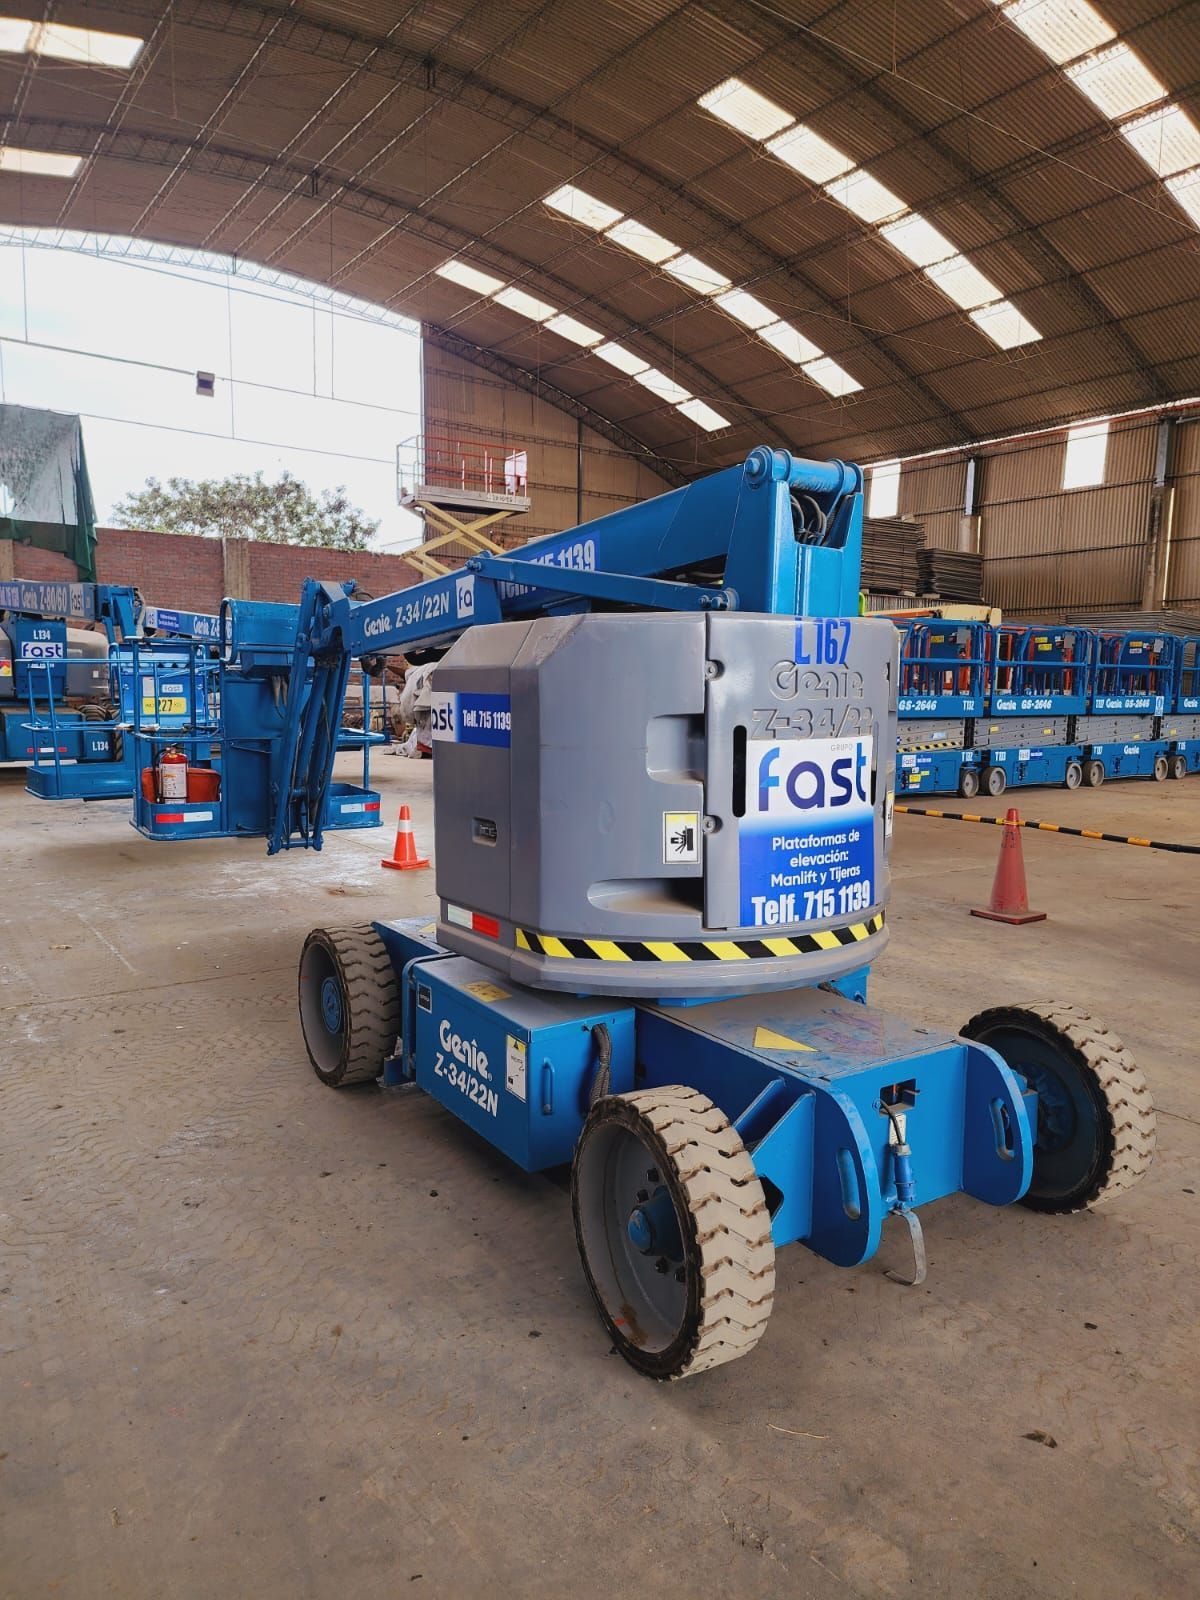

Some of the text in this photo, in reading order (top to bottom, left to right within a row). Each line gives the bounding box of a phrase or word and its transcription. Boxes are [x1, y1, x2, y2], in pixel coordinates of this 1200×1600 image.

[364, 613, 391, 637] Genie
[395, 591, 450, 628] Z-34/22N
[33, 629, 50, 640] L134
[22, 643, 62, 657] fast
[898, 700, 938, 711] GS-2646
[996, 699, 1053, 711] Genie GS-2646
[1105, 698, 1122, 709] Genie
[432, 702, 454, 731] ast
[479, 710, 492, 729] 715
[492, 711, 512, 731] 1139
[92, 741, 109, 751] L134
[831, 743, 853, 752] GRUPO
[1123, 745, 1140, 755] Genie
[758, 742, 868, 812] fast
[772, 829, 860, 851] Plataformas de
[790, 849, 849, 867] elevación:
[771, 865, 860, 887] Manlift y Tijeras
[751, 880, 871, 926] Telf. 715 1139
[439, 1019, 490, 1081] Genie
[434, 1052, 499, 1118] Z-34/22N
